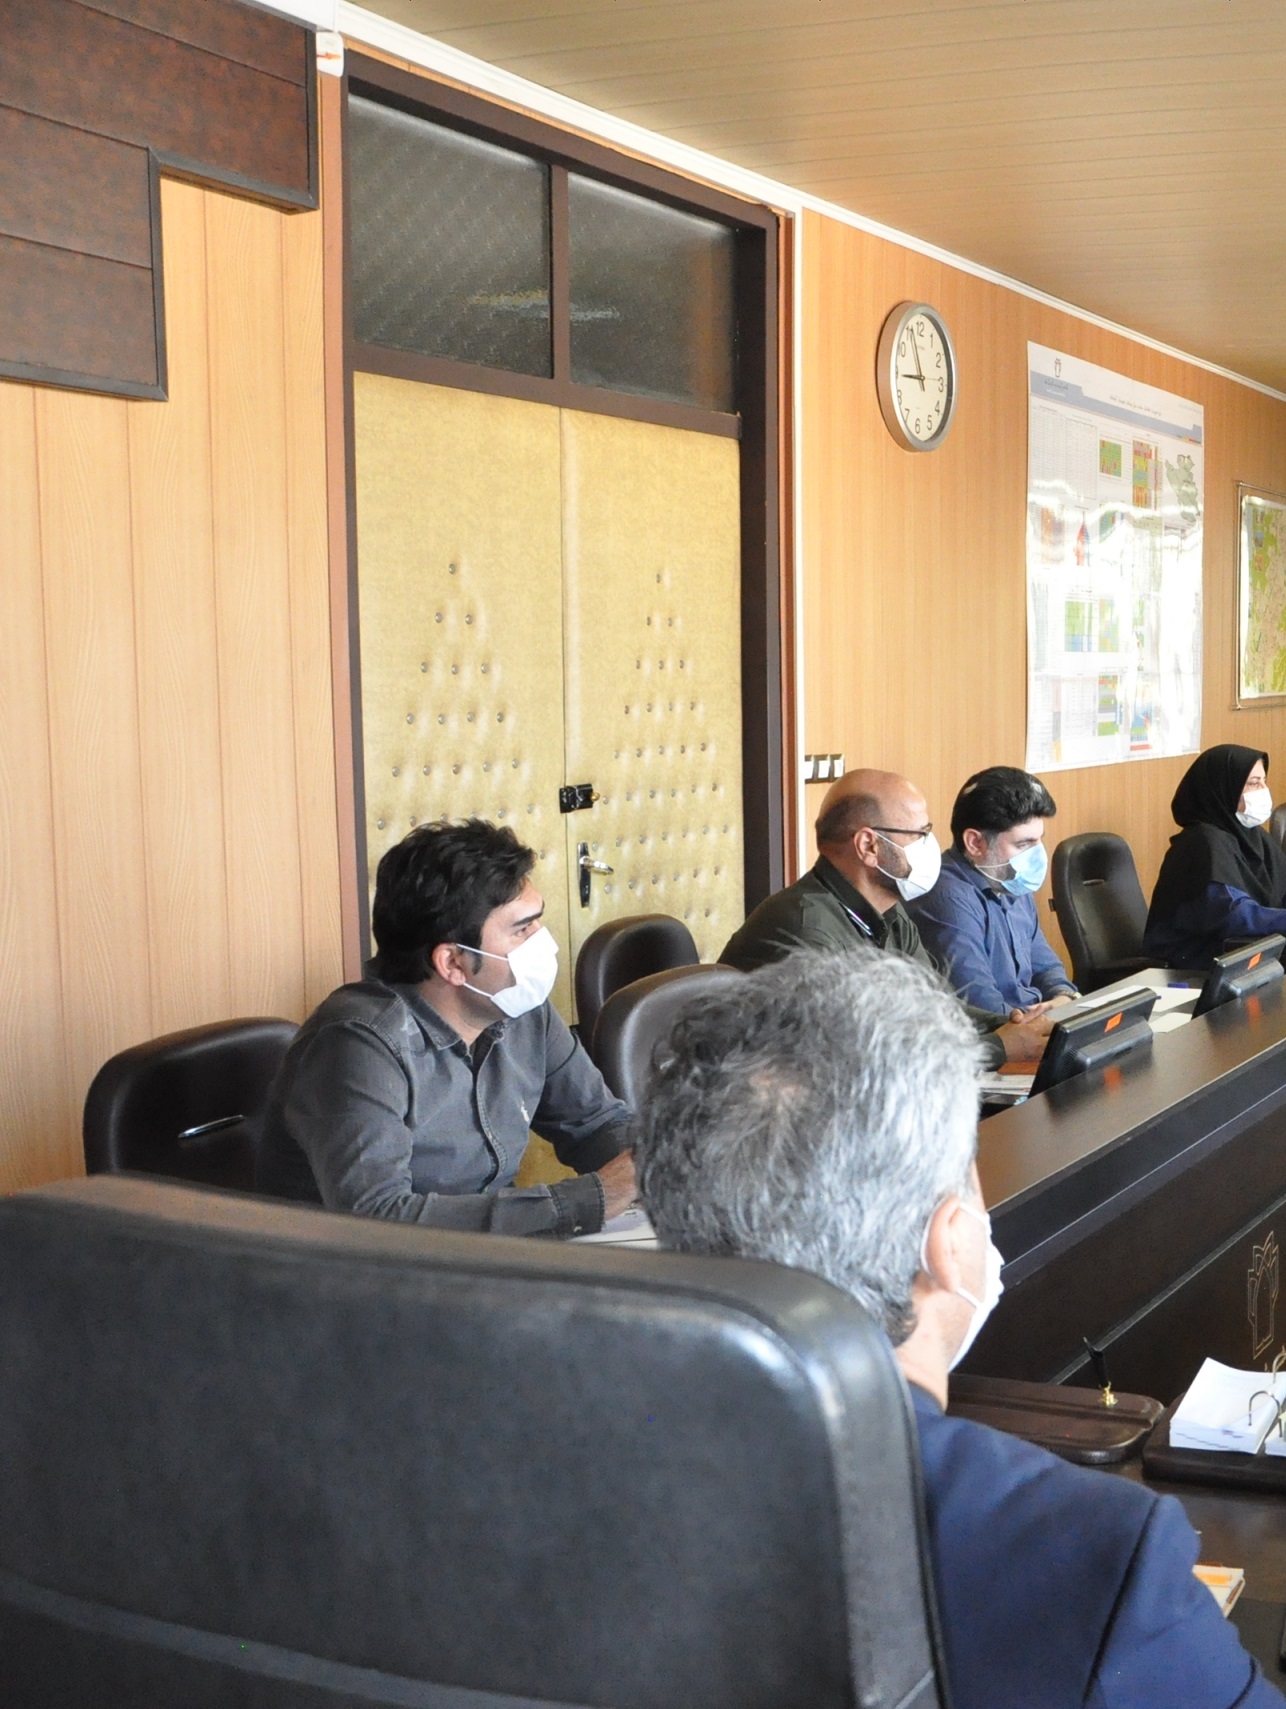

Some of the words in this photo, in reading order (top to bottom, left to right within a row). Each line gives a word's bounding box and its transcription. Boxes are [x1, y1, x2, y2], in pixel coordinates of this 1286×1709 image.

[916, 321, 925, 338] 12
[929, 333, 934, 349] 1
[935, 352, 942, 369] 2
[938, 376, 944, 393] 3
[904, 408, 910, 424] 7
[934, 400, 941, 416] 4
[914, 417, 921, 434] 6
[926, 414, 933, 431] 5
